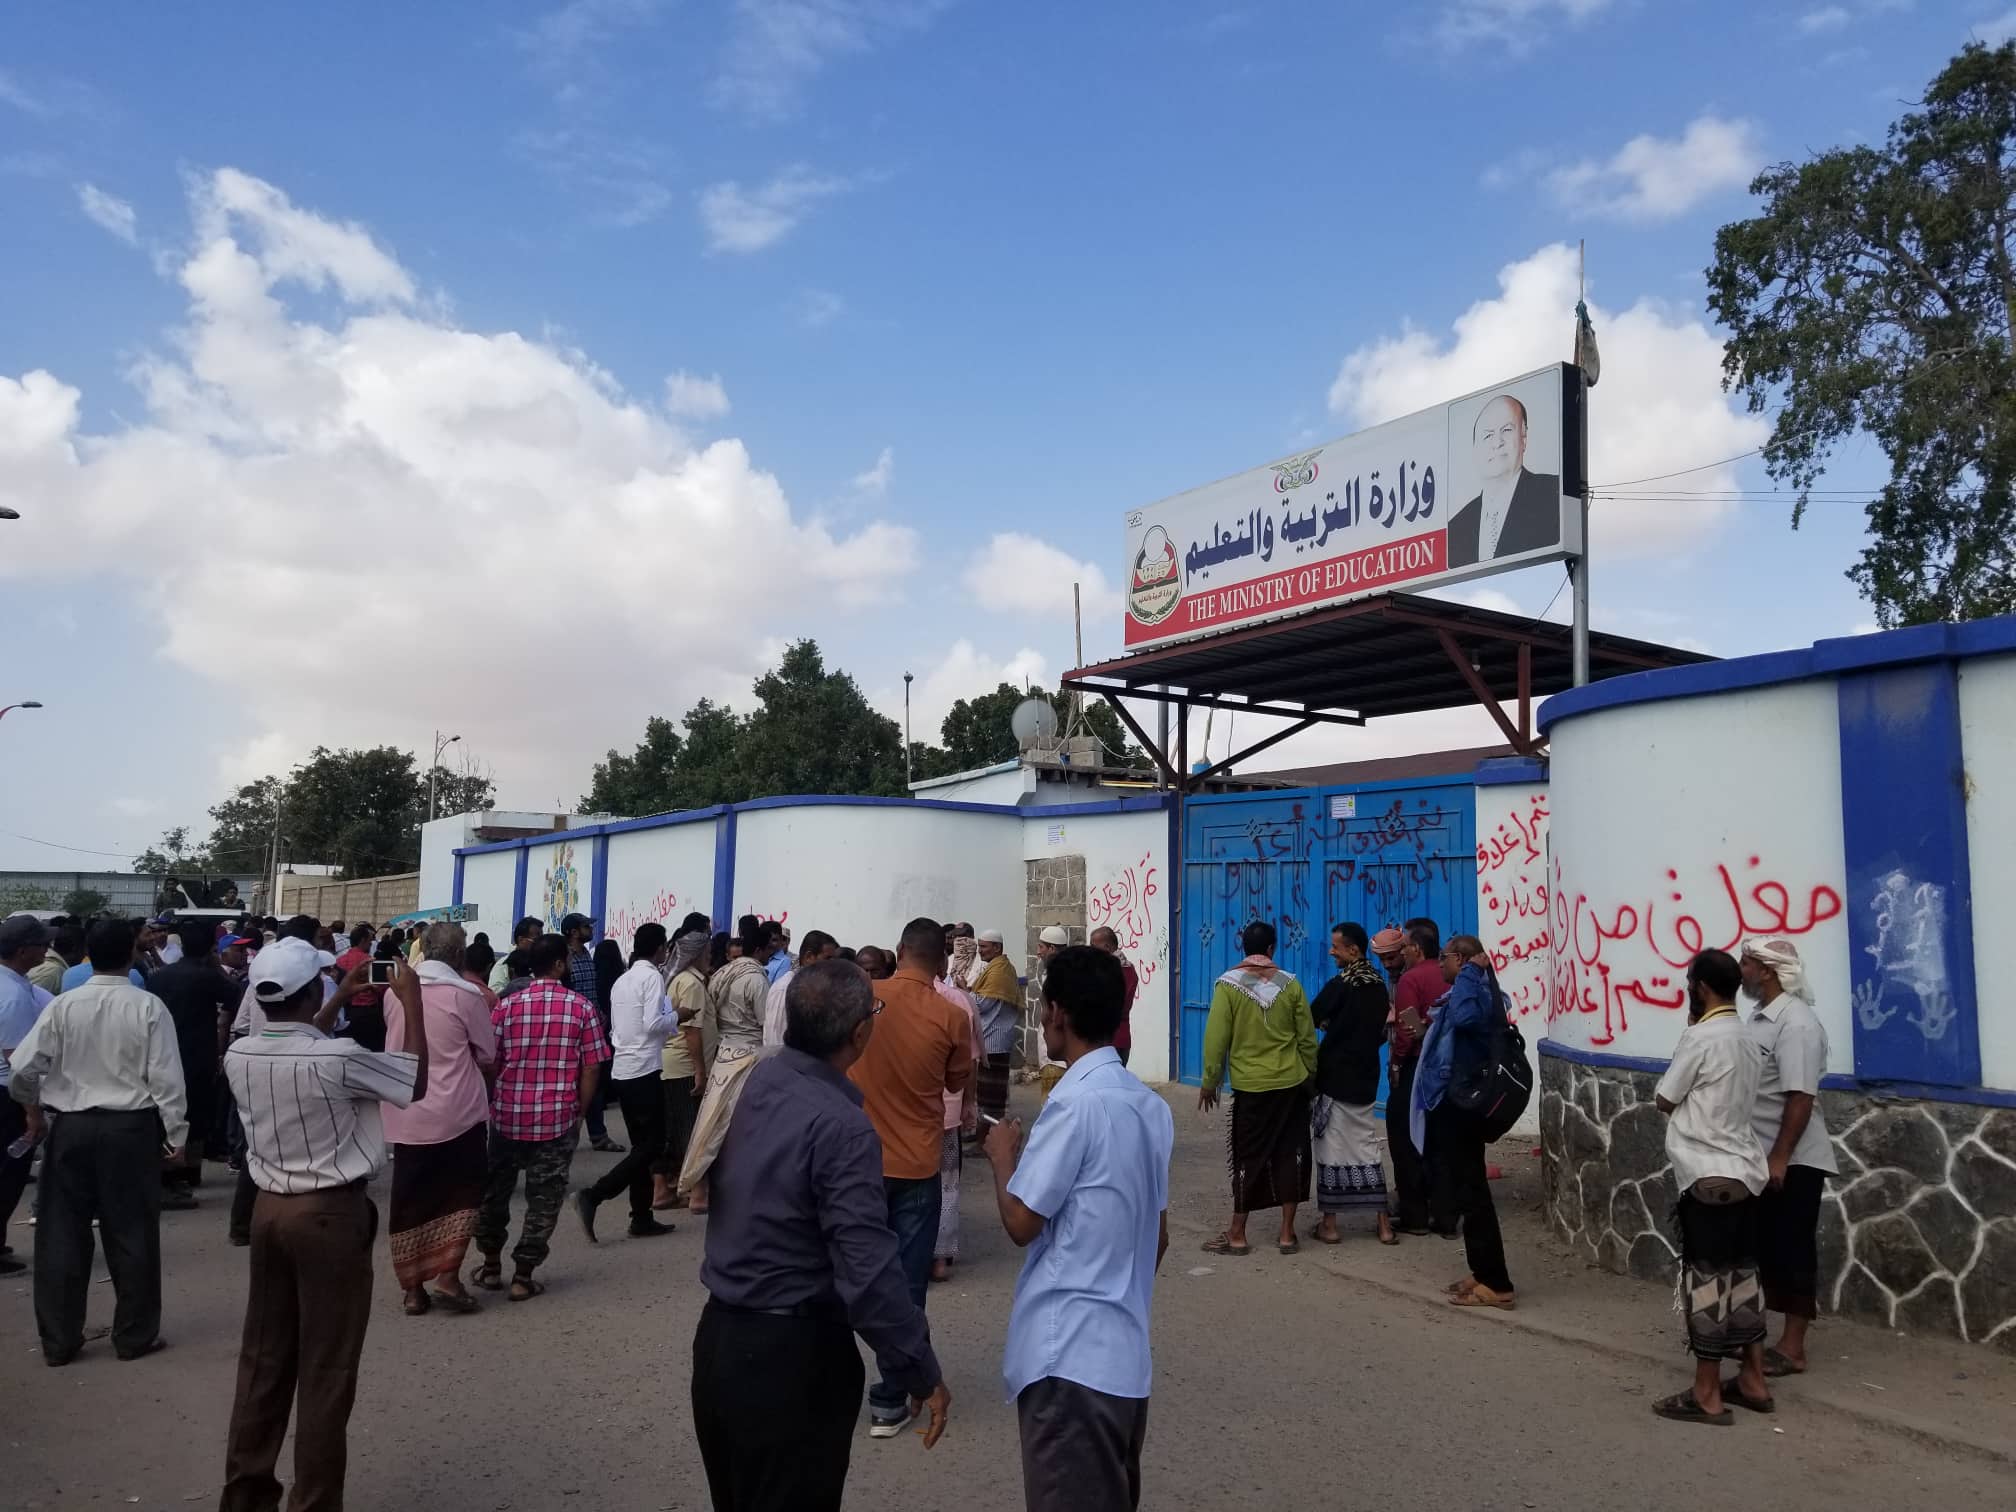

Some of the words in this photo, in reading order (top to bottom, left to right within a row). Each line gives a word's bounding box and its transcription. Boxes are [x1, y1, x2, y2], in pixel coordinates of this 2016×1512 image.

[1281, 475, 1360, 553] التربية
[1370, 460, 1436, 529] وزارة
[1186, 507, 1273, 589] والتعليم
[1187, 594, 1216, 623] THE
[1219, 574, 1295, 616] MINISTRY
[1299, 568, 1321, 596] OF
[1325, 538, 1435, 590] EDUCATION
[1647, 855, 1842, 969] مغلق
